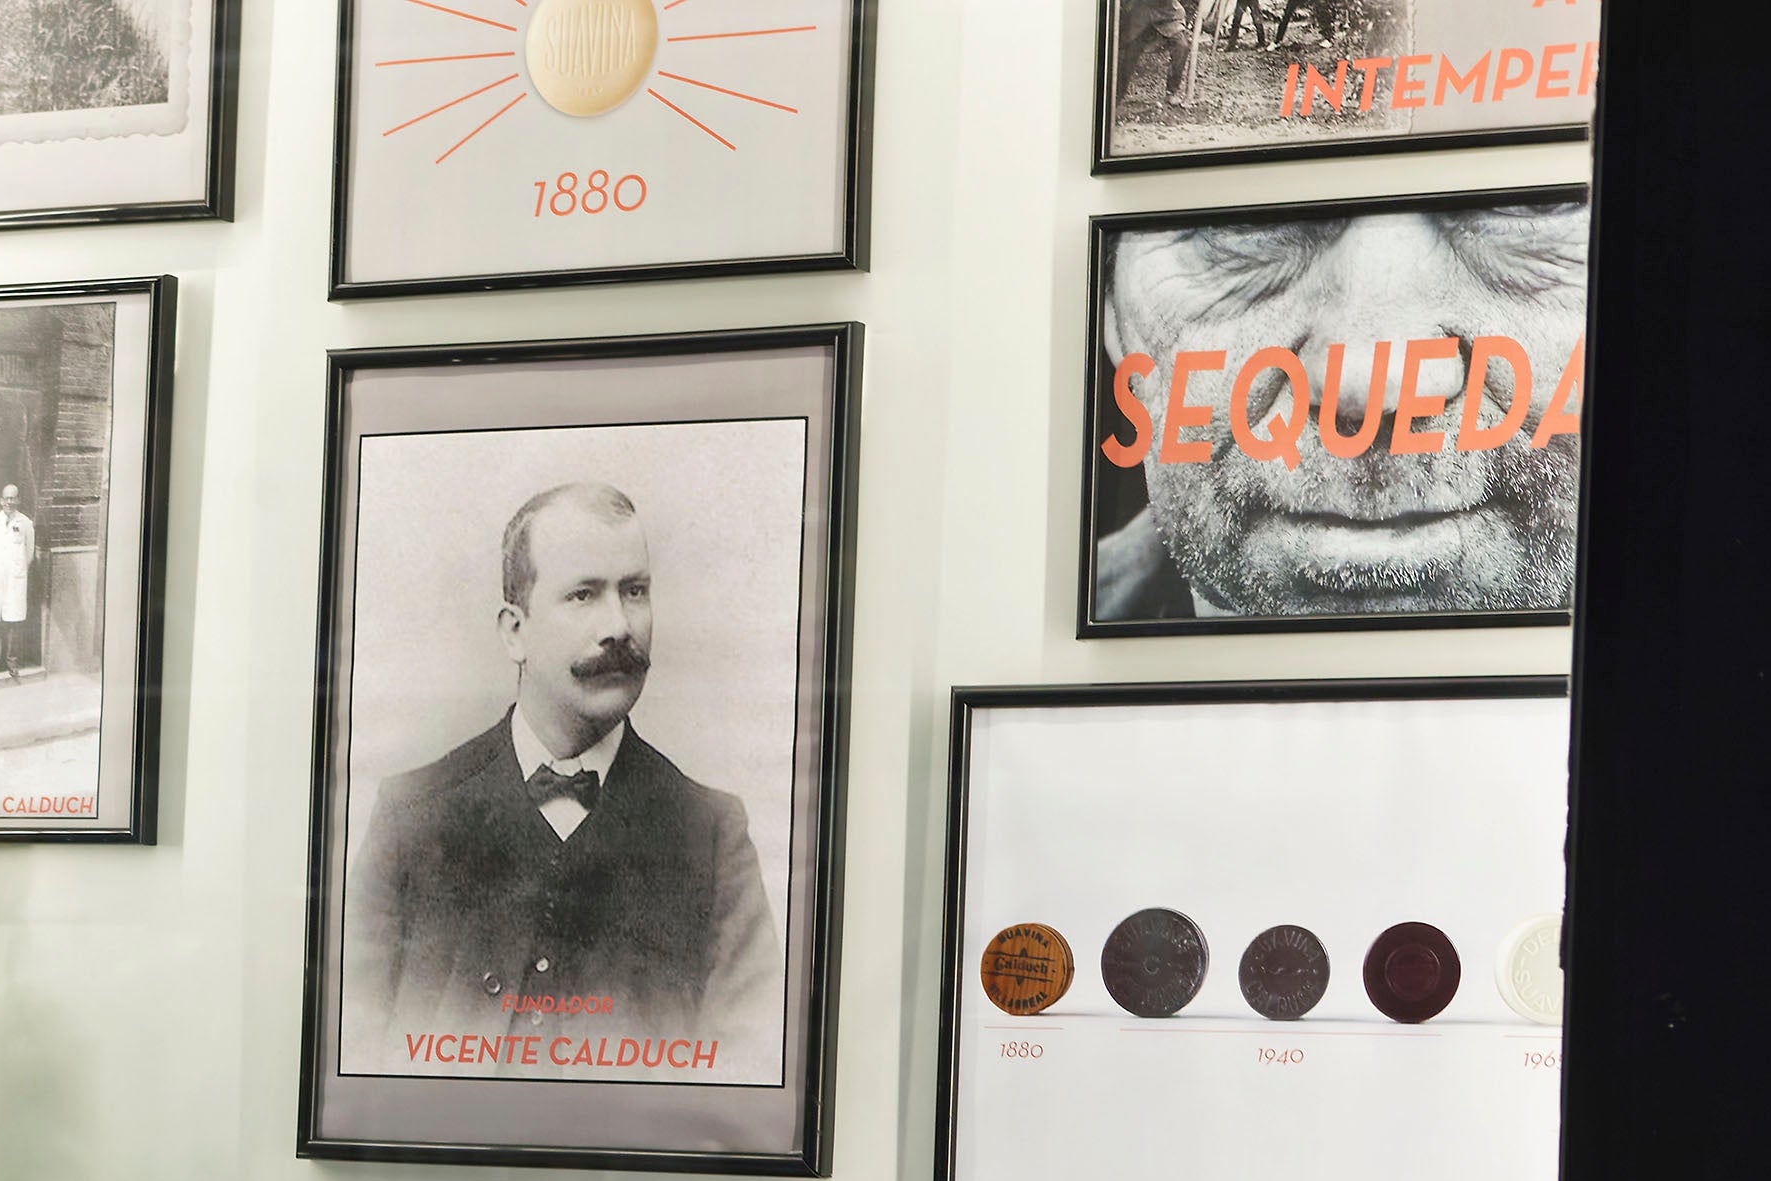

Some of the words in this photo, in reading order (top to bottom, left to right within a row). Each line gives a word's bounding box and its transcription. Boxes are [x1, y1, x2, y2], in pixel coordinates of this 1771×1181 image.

[532, 168, 648, 218] 1880
[2, 796, 94, 814] CALDUCH
[501, 994, 615, 1016] FUNDADOR
[405, 1033, 542, 1066] VICENTE
[548, 1036, 719, 1070] CALDUCH
[1000, 1039, 1044, 1059] 1880
[1257, 1047, 1305, 1066] 1940
[1523, 1050, 1562, 1072] 196
